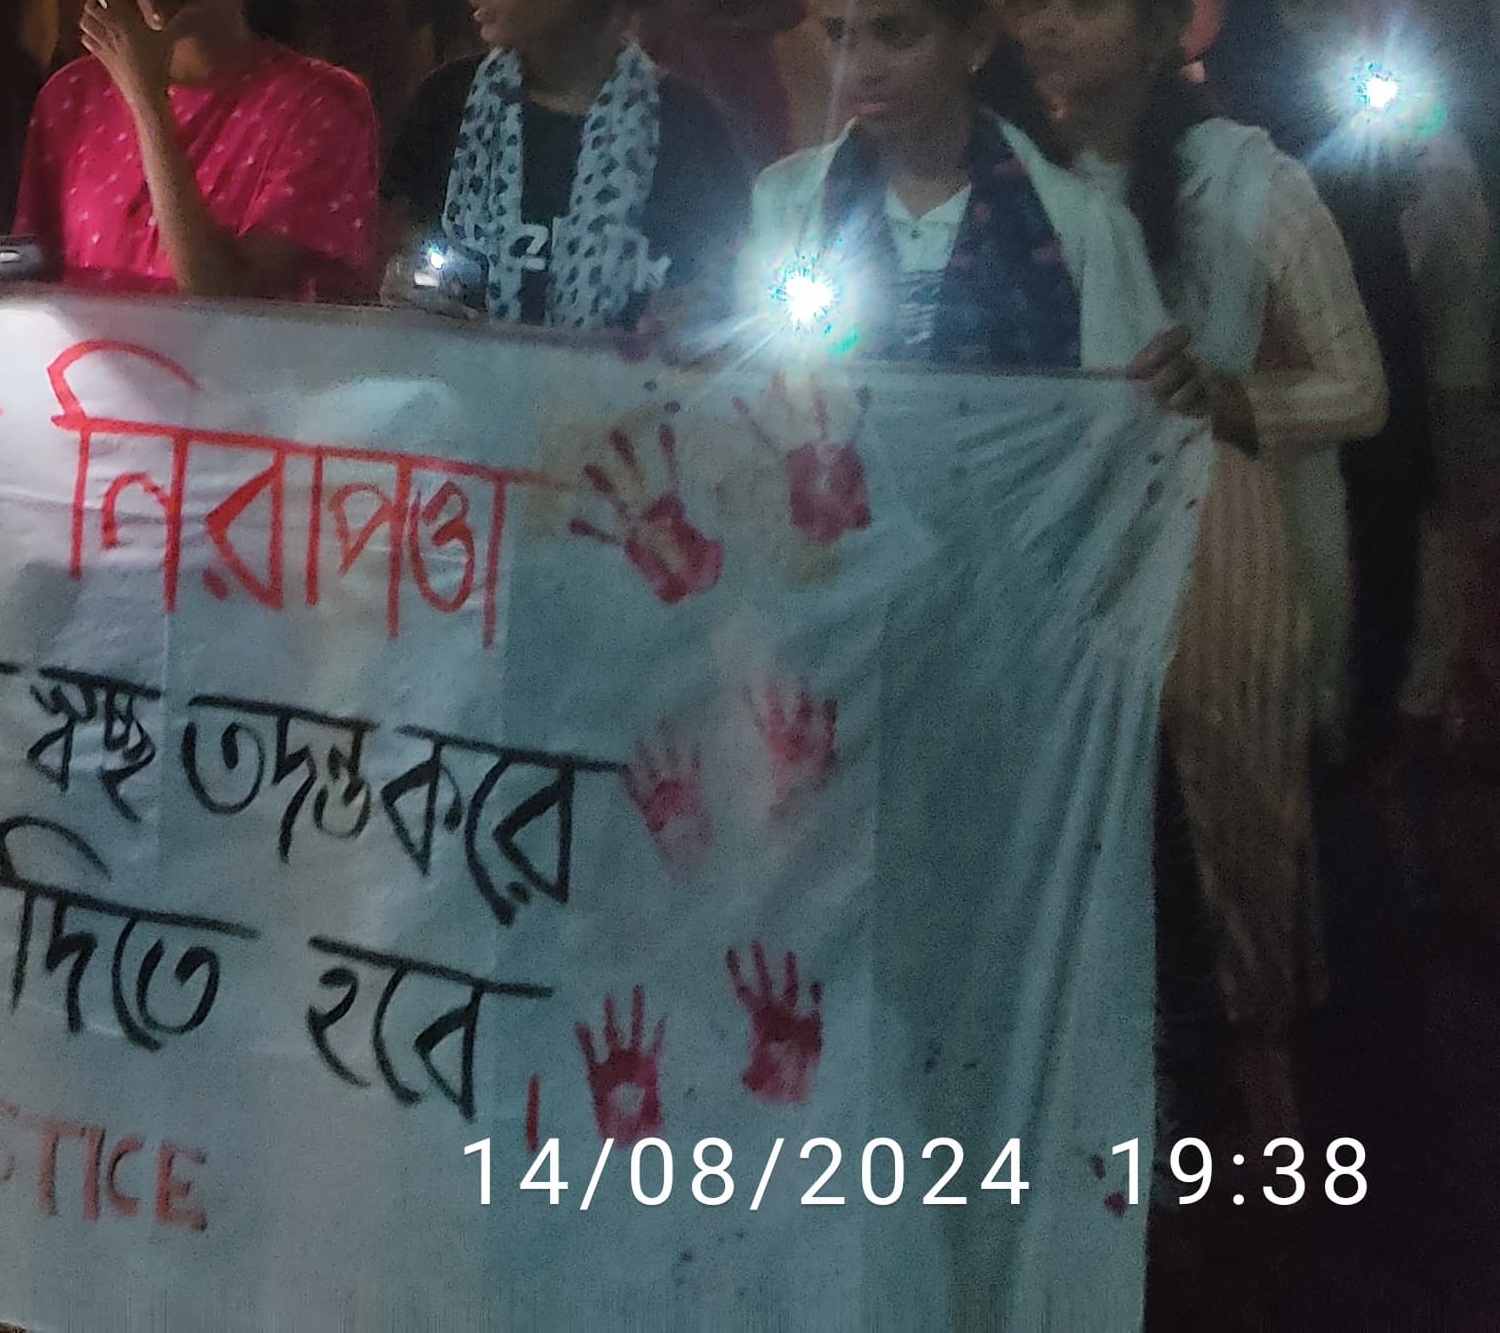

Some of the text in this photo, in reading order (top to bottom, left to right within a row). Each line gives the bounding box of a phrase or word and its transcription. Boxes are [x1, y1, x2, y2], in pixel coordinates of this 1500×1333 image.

[181, 693, 381, 864] তদন্ত
[382, 723, 628, 927] করে
[307, 935, 555, 1124] হবে
